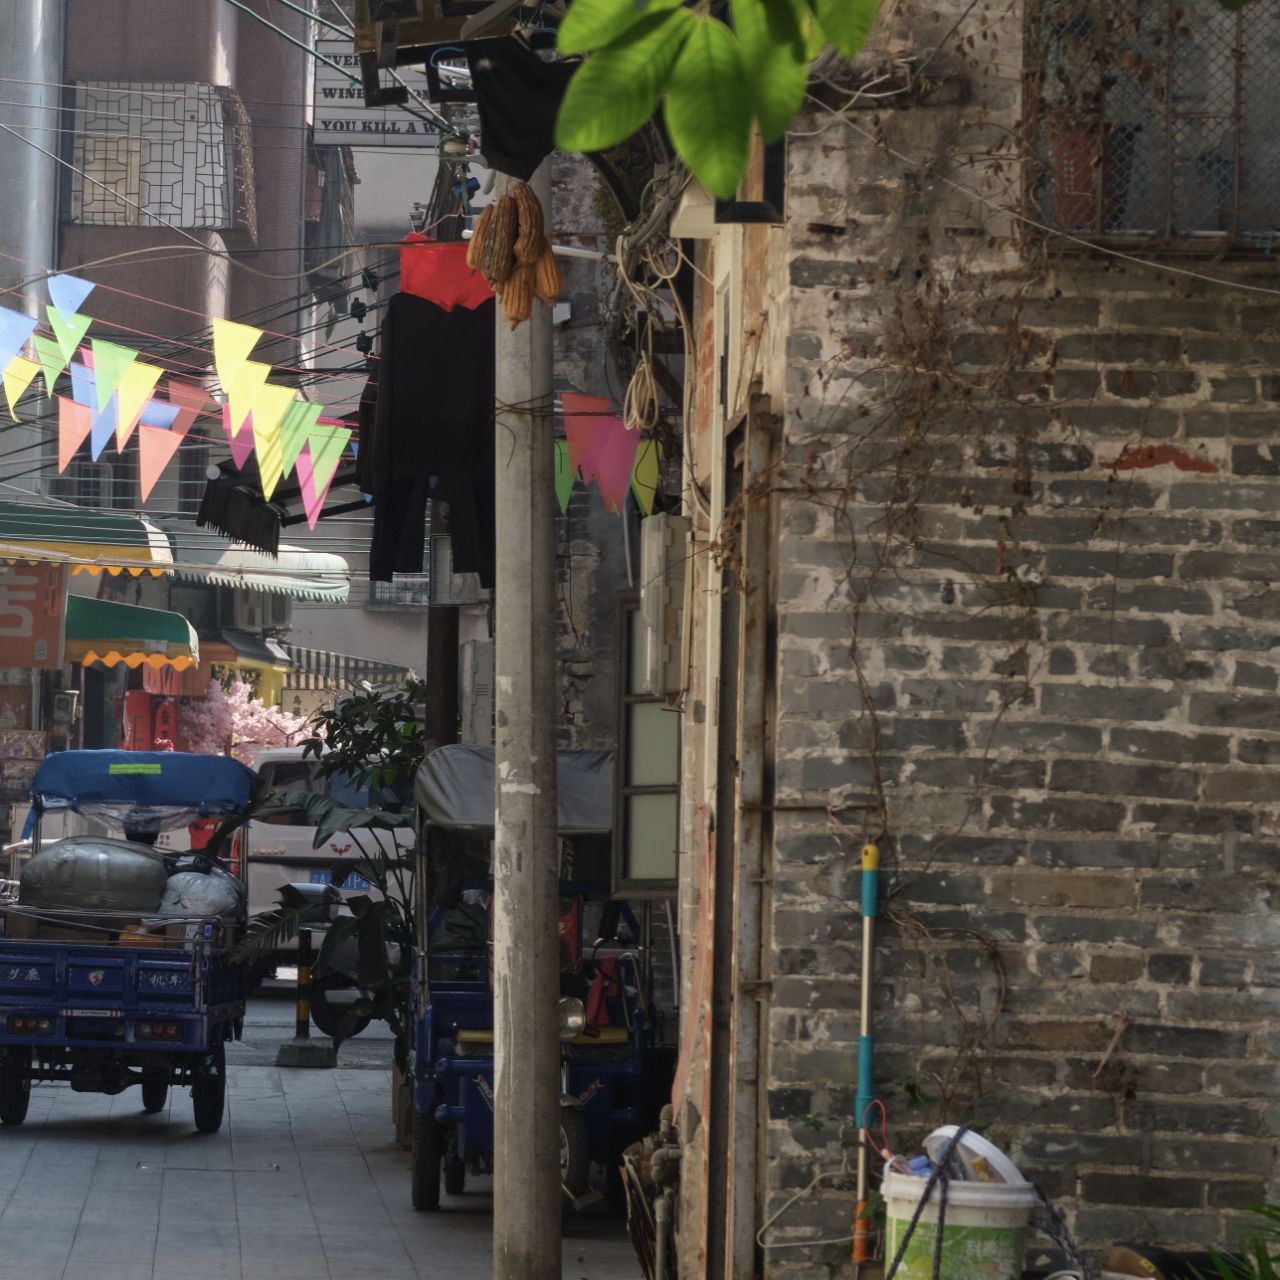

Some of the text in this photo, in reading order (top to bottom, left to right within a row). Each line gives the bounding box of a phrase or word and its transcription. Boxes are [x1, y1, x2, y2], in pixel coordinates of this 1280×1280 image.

[322, 120, 356, 132] YOU
[361, 121, 401, 133] KILL
[405, 122, 417, 133] A
